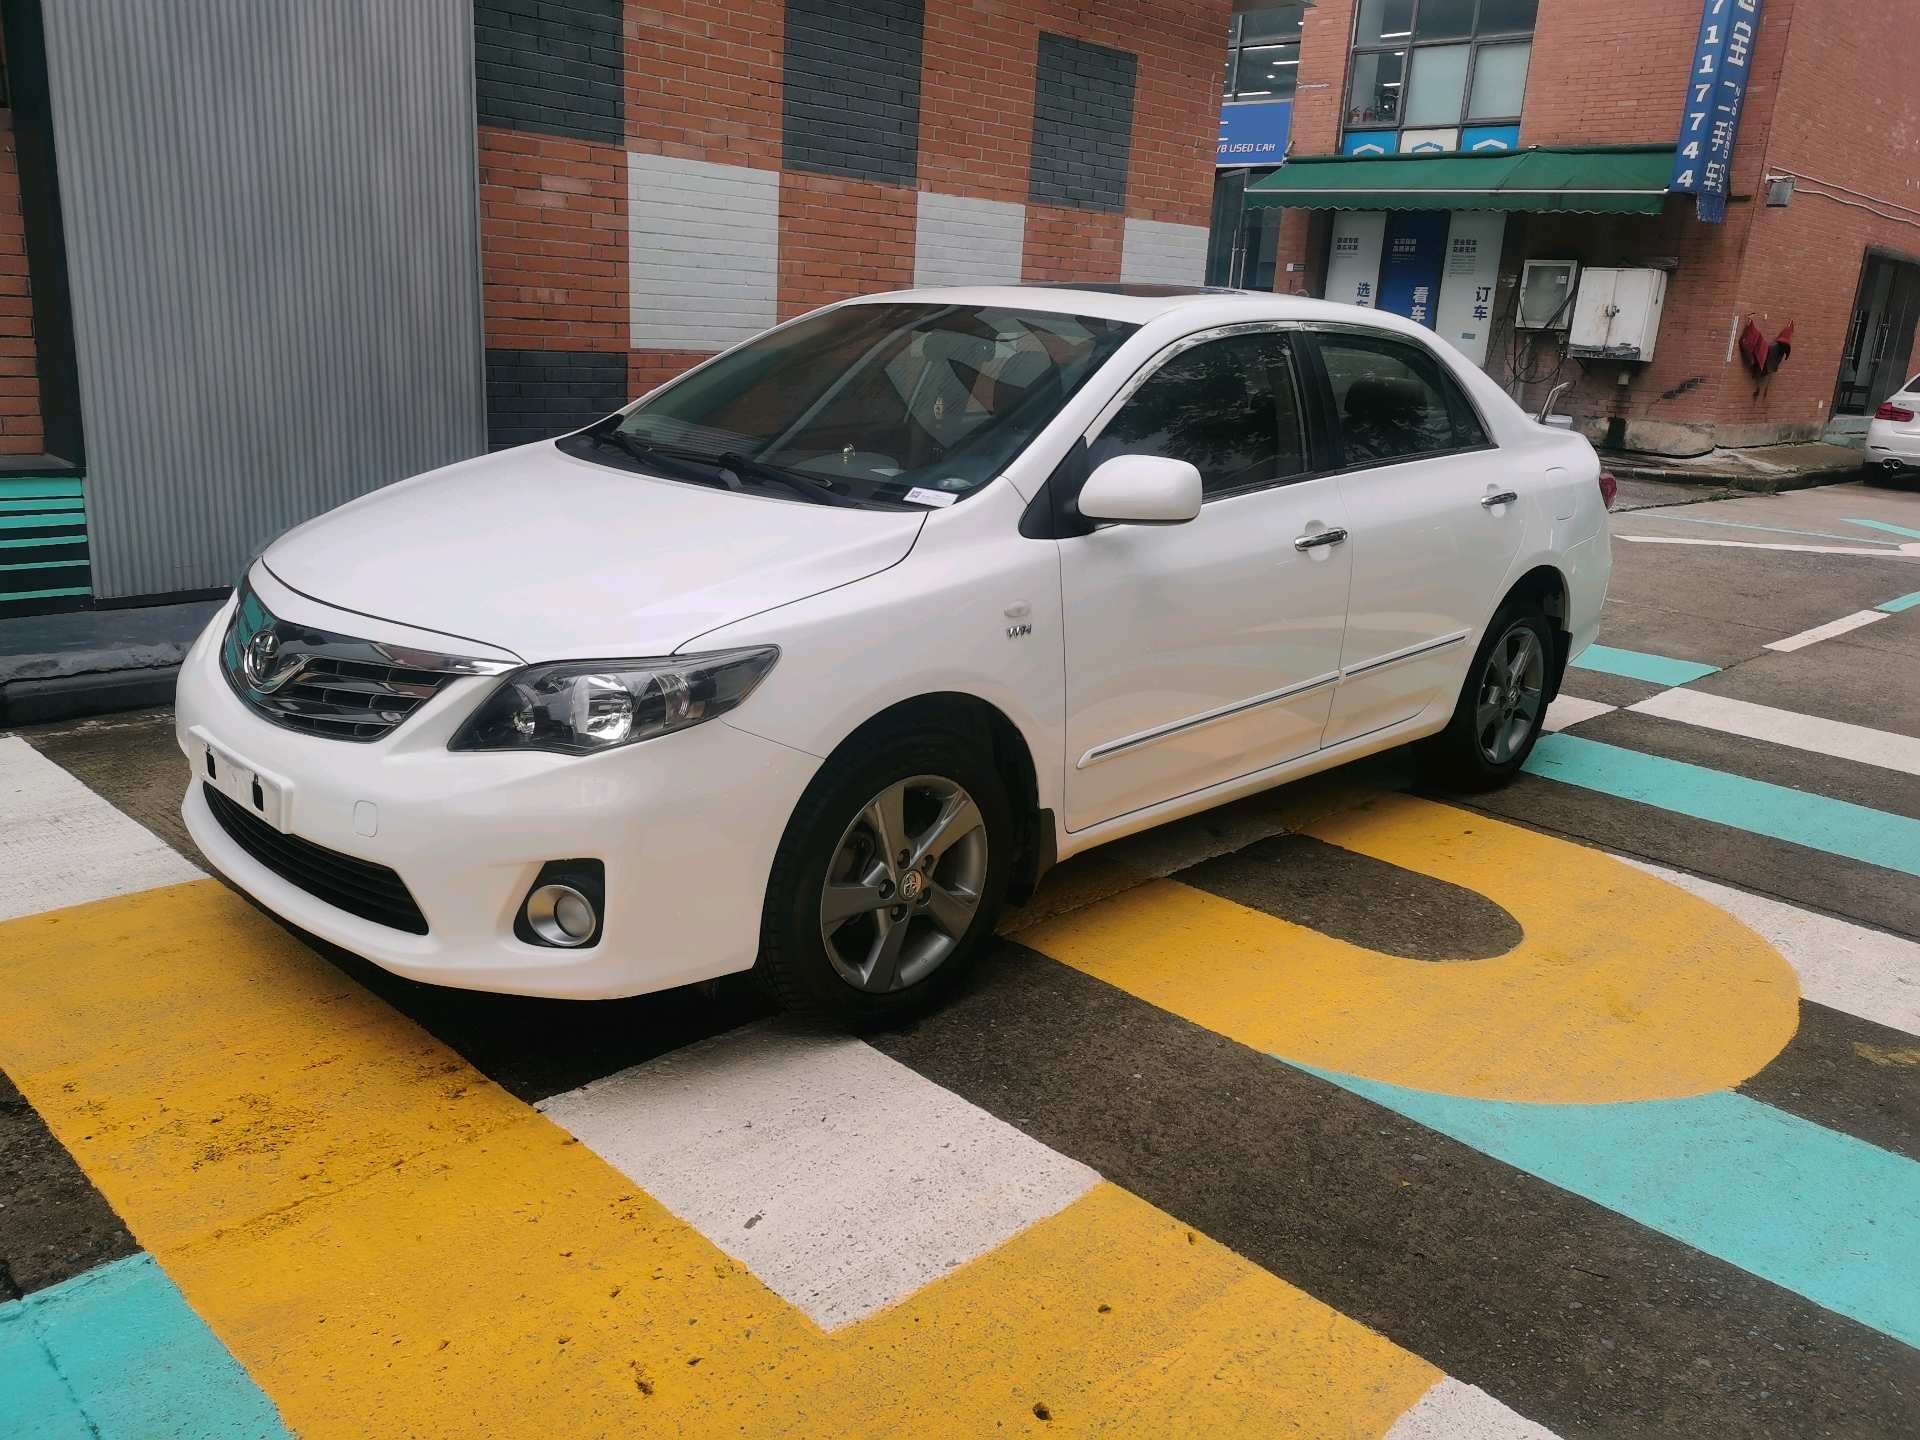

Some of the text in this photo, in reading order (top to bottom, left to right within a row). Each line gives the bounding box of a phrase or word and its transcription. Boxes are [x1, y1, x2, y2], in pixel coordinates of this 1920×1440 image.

[1676, 0, 1724, 188] 7117744
[1703, 0, 1756, 191] 宝二手车
[1229, 143, 1253, 153] USED
[1410, 286, 1429, 322] 看车
[1472, 286, 1491, 321] 订车
